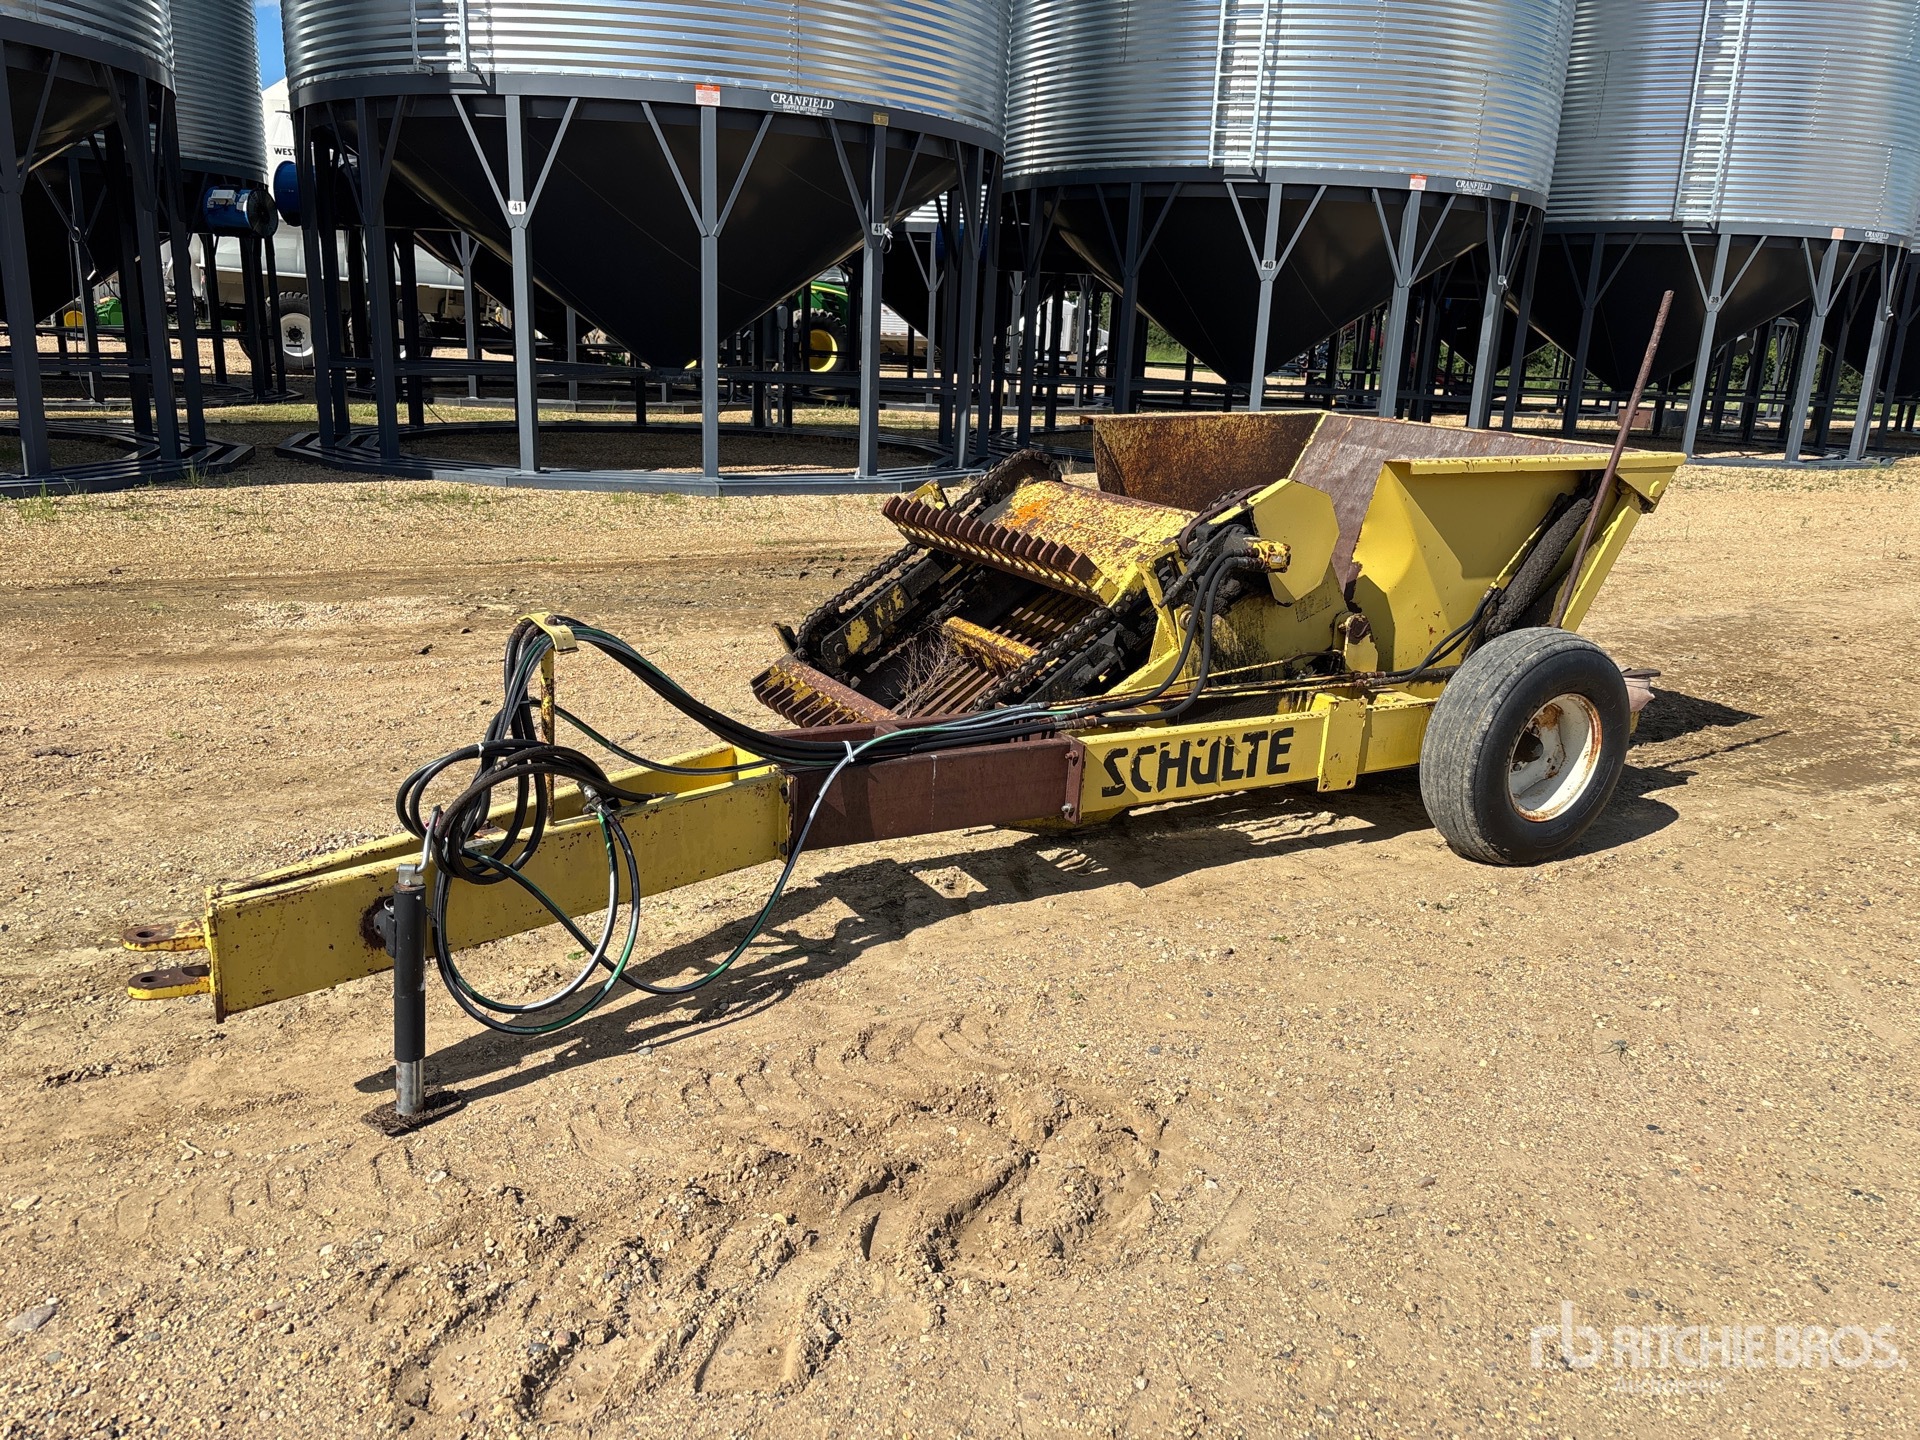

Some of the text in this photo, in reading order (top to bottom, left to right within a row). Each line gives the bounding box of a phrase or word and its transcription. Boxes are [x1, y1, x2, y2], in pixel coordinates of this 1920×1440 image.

[770, 92, 835, 110] CRANFIELD
[1455, 179, 1493, 191] CRANFIELD
[511, 202, 523, 213] 41
[874, 223, 883, 234] 41
[1263, 260, 1274, 270] 40
[1101, 726, 1295, 798] SCHULTE
